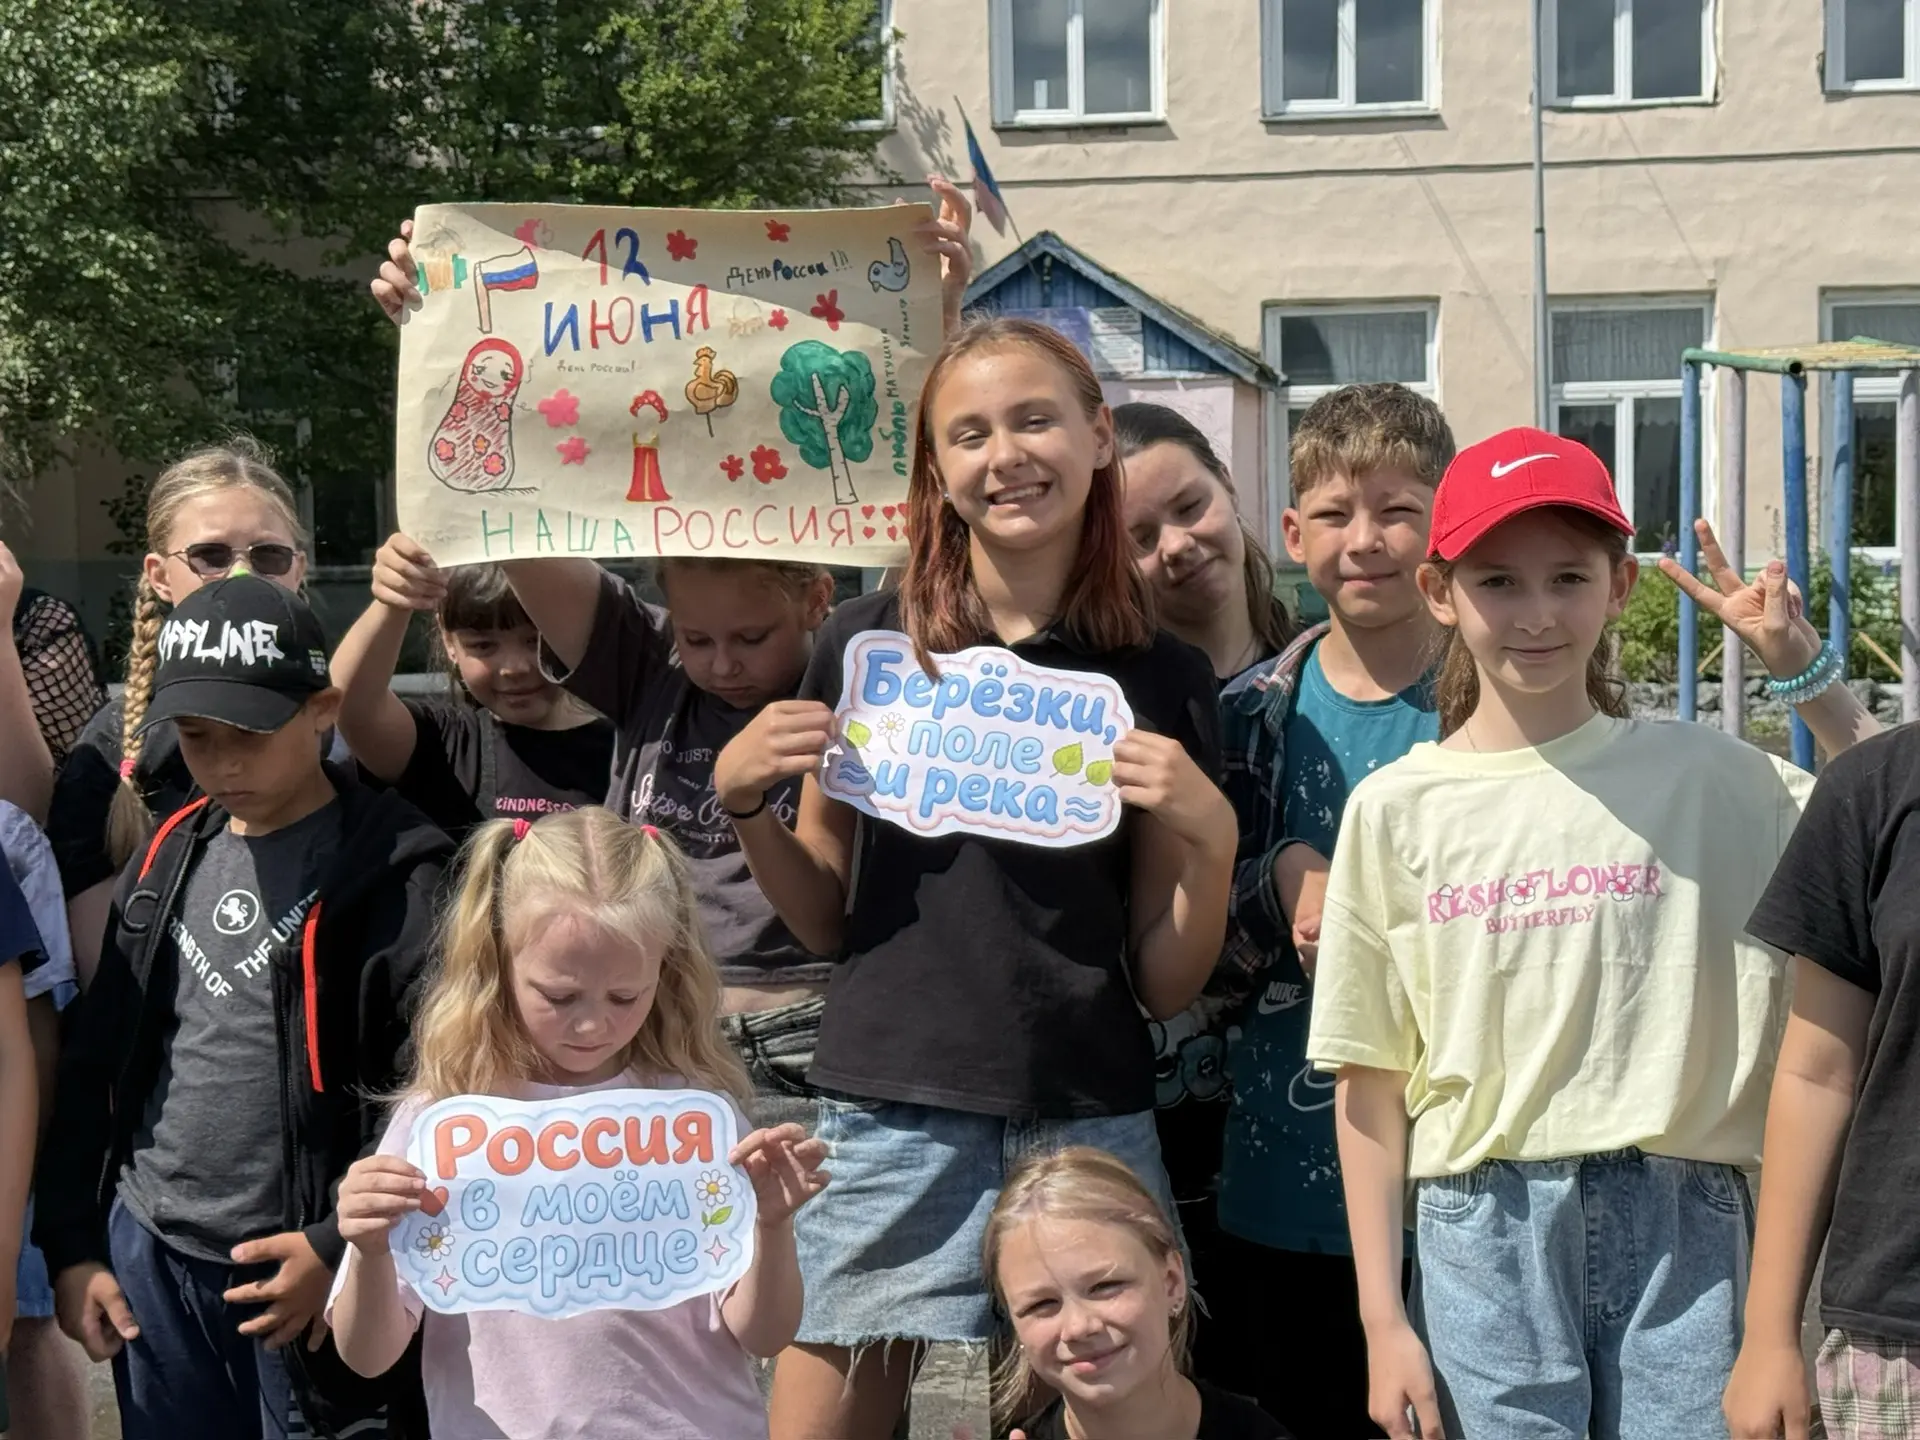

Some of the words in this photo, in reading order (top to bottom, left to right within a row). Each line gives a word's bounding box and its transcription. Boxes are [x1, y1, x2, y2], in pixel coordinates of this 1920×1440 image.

[582, 227, 651, 287] 12
[543, 283, 710, 357] ИЮНЯ
[482, 508, 635, 557] НАША
[653, 503, 854, 555] РОССИЯ
[158, 618, 286, 670] OFFLINE
[862, 649, 1117, 746] Берёзки,
[676, 748, 713, 764] JUST
[907, 720, 1044, 775] поле
[875, 760, 910, 799] и
[919, 767, 1059, 826] река
[1485, 904, 1596, 935] BUTTERFLY
[205, 971, 233, 997] OF
[1266, 981, 1302, 1002] NIKE
[434, 1111, 714, 1180] Россия
[460, 1178, 501, 1231] в
[520, 1170, 690, 1227] моём
[462, 1229, 698, 1298] сердце
